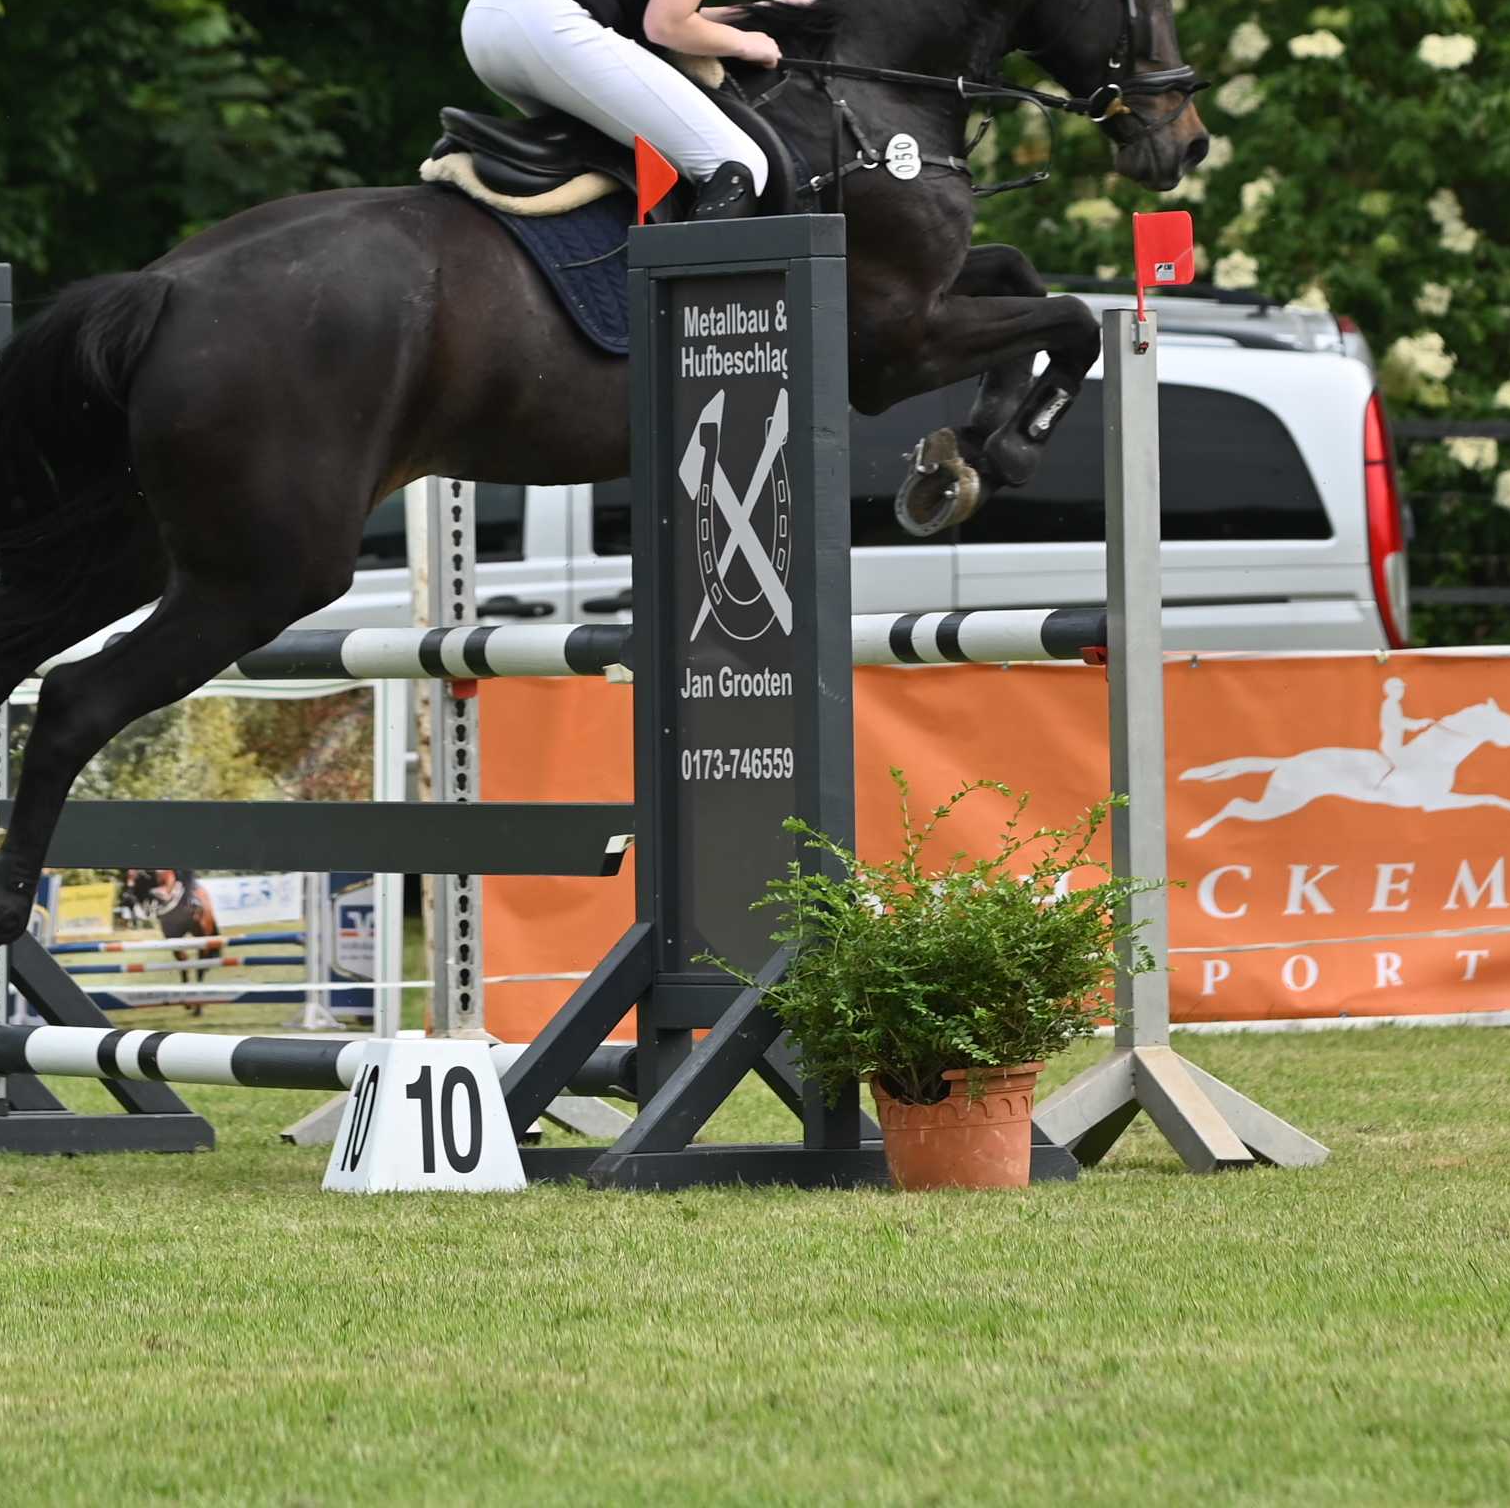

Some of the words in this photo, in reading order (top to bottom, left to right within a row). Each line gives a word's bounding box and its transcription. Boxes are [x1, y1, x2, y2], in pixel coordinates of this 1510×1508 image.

[684, 303, 769, 337] Metallbau
[775, 300, 787, 332] &
[681, 667, 713, 698] Jan
[719, 666, 792, 697] Grooten
[682, 747, 794, 780] 0173-746559
[341, 1064, 379, 1173] 10
[406, 1065, 482, 1173] 10
